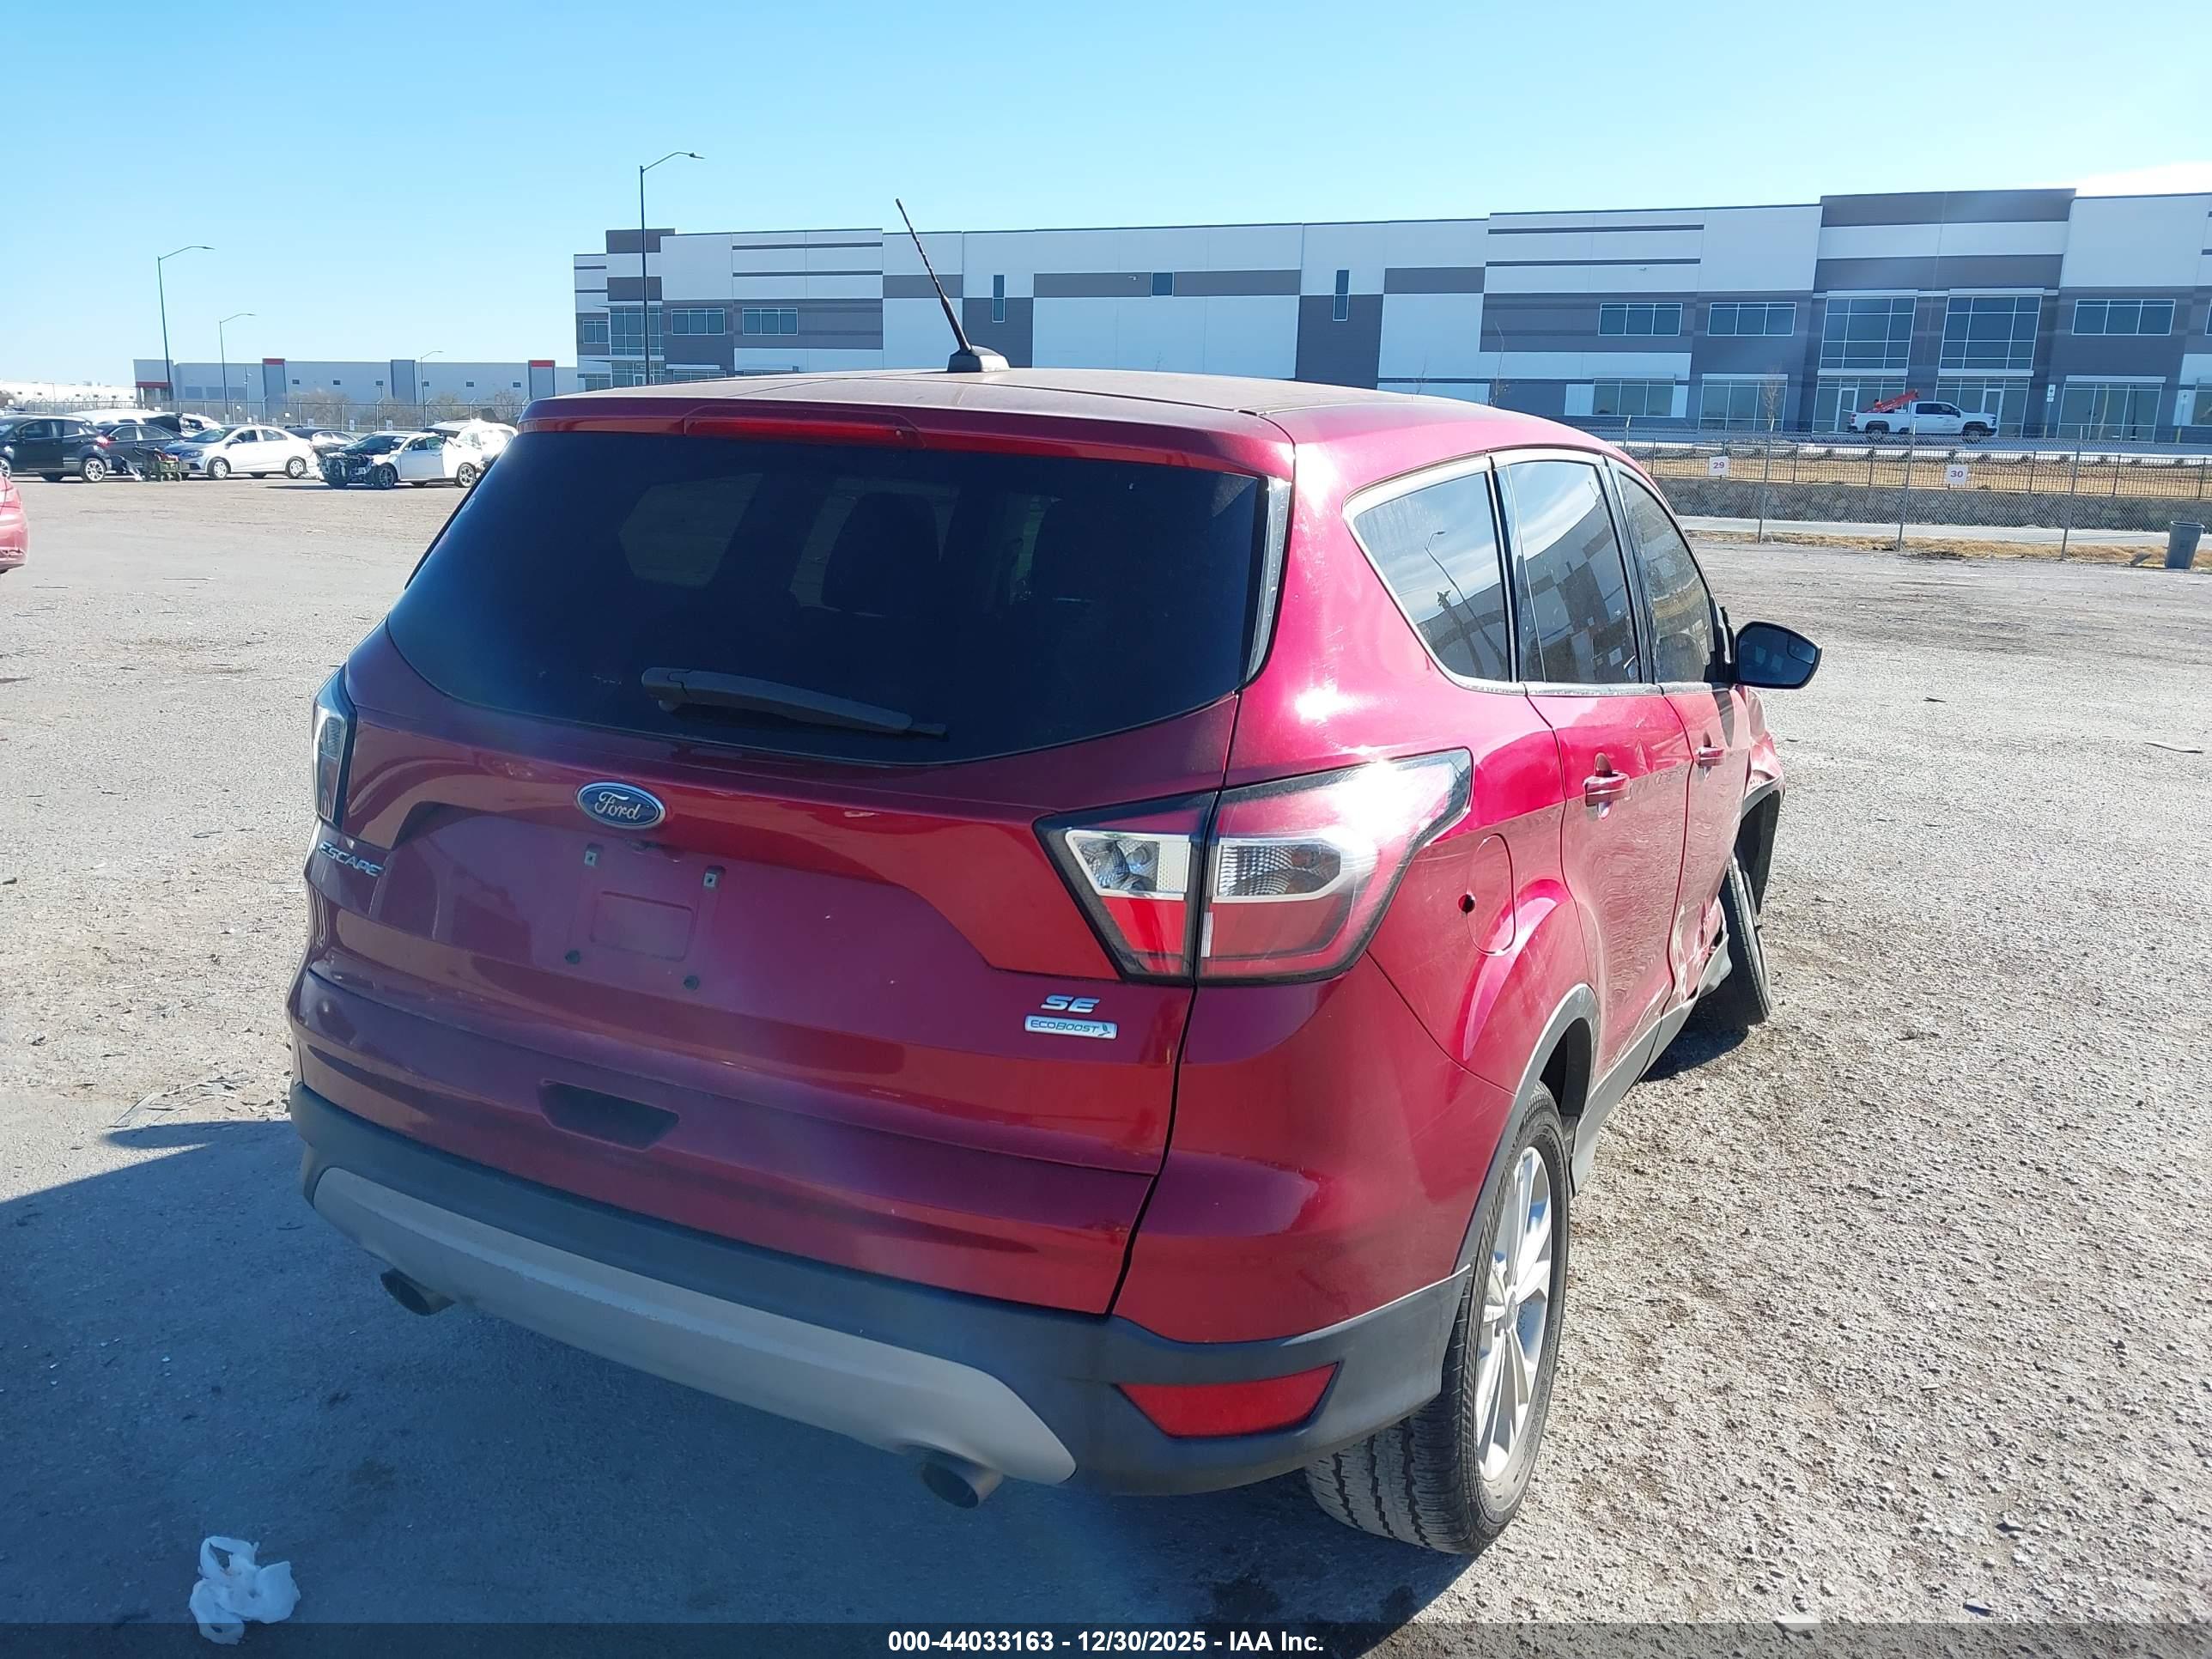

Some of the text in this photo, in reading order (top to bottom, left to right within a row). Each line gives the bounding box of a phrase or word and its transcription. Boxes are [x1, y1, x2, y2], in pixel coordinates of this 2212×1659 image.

[1950, 470, 1964, 478] 30
[594, 791, 641, 821] Ford
[319, 840, 385, 878] ESCAPE
[1040, 994, 1100, 1014] SE
[1030, 1018, 1099, 1034] ECOBOOST
